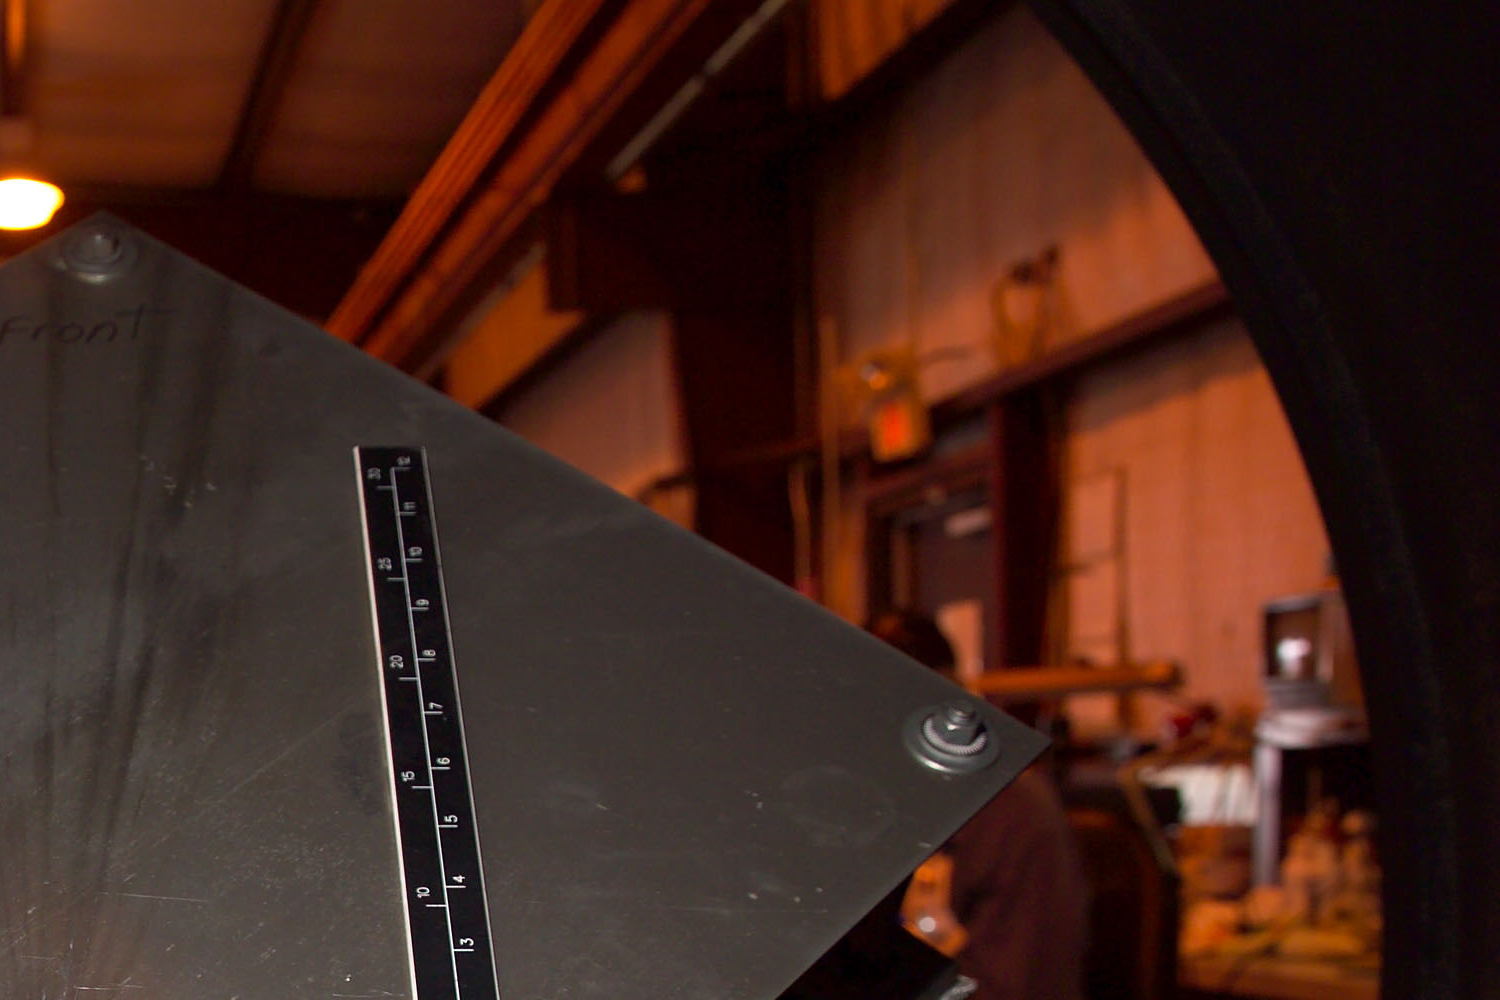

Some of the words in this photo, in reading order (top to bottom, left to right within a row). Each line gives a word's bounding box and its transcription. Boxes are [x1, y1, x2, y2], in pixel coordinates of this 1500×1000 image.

[403, 501, 416, 511] 11
[409, 546, 423, 558] 10
[378, 557, 392, 571] 25
[416, 599, 429, 607] 9
[423, 649, 436, 658] 8
[390, 654, 404, 670] 20
[429, 701, 442, 710] 7
[437, 757, 450, 765] 6
[401, 771, 415, 782] 15
[445, 814, 458, 822] 5
[452, 875, 466, 883] 4
[417, 886, 430, 898] 10
[460, 938, 474, 946] 3
